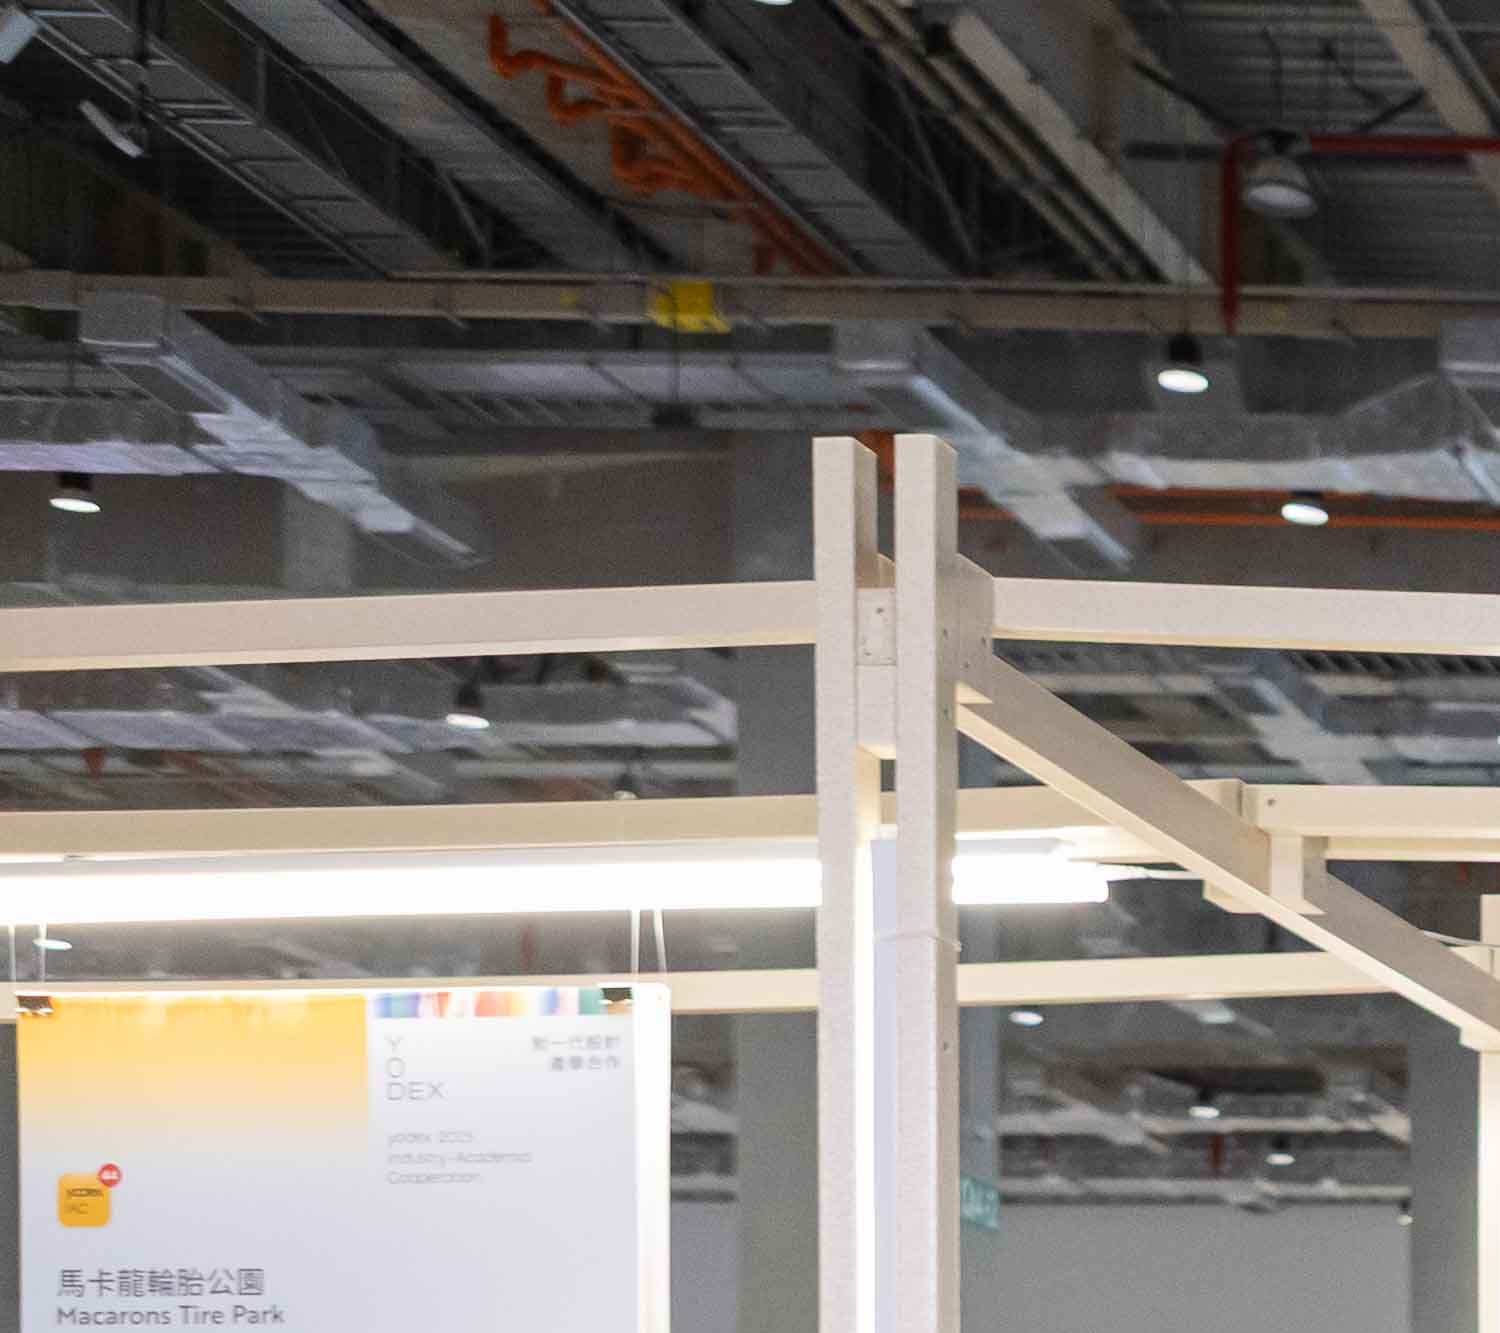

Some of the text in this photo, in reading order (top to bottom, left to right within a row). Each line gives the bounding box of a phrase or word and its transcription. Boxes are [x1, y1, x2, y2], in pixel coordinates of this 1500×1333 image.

[386, 1081, 445, 1101] DEX
[58, 1268, 264, 1298] 馬卡龍輪胎公園
[57, 1305, 285, 1325] Macarons Tire Park
